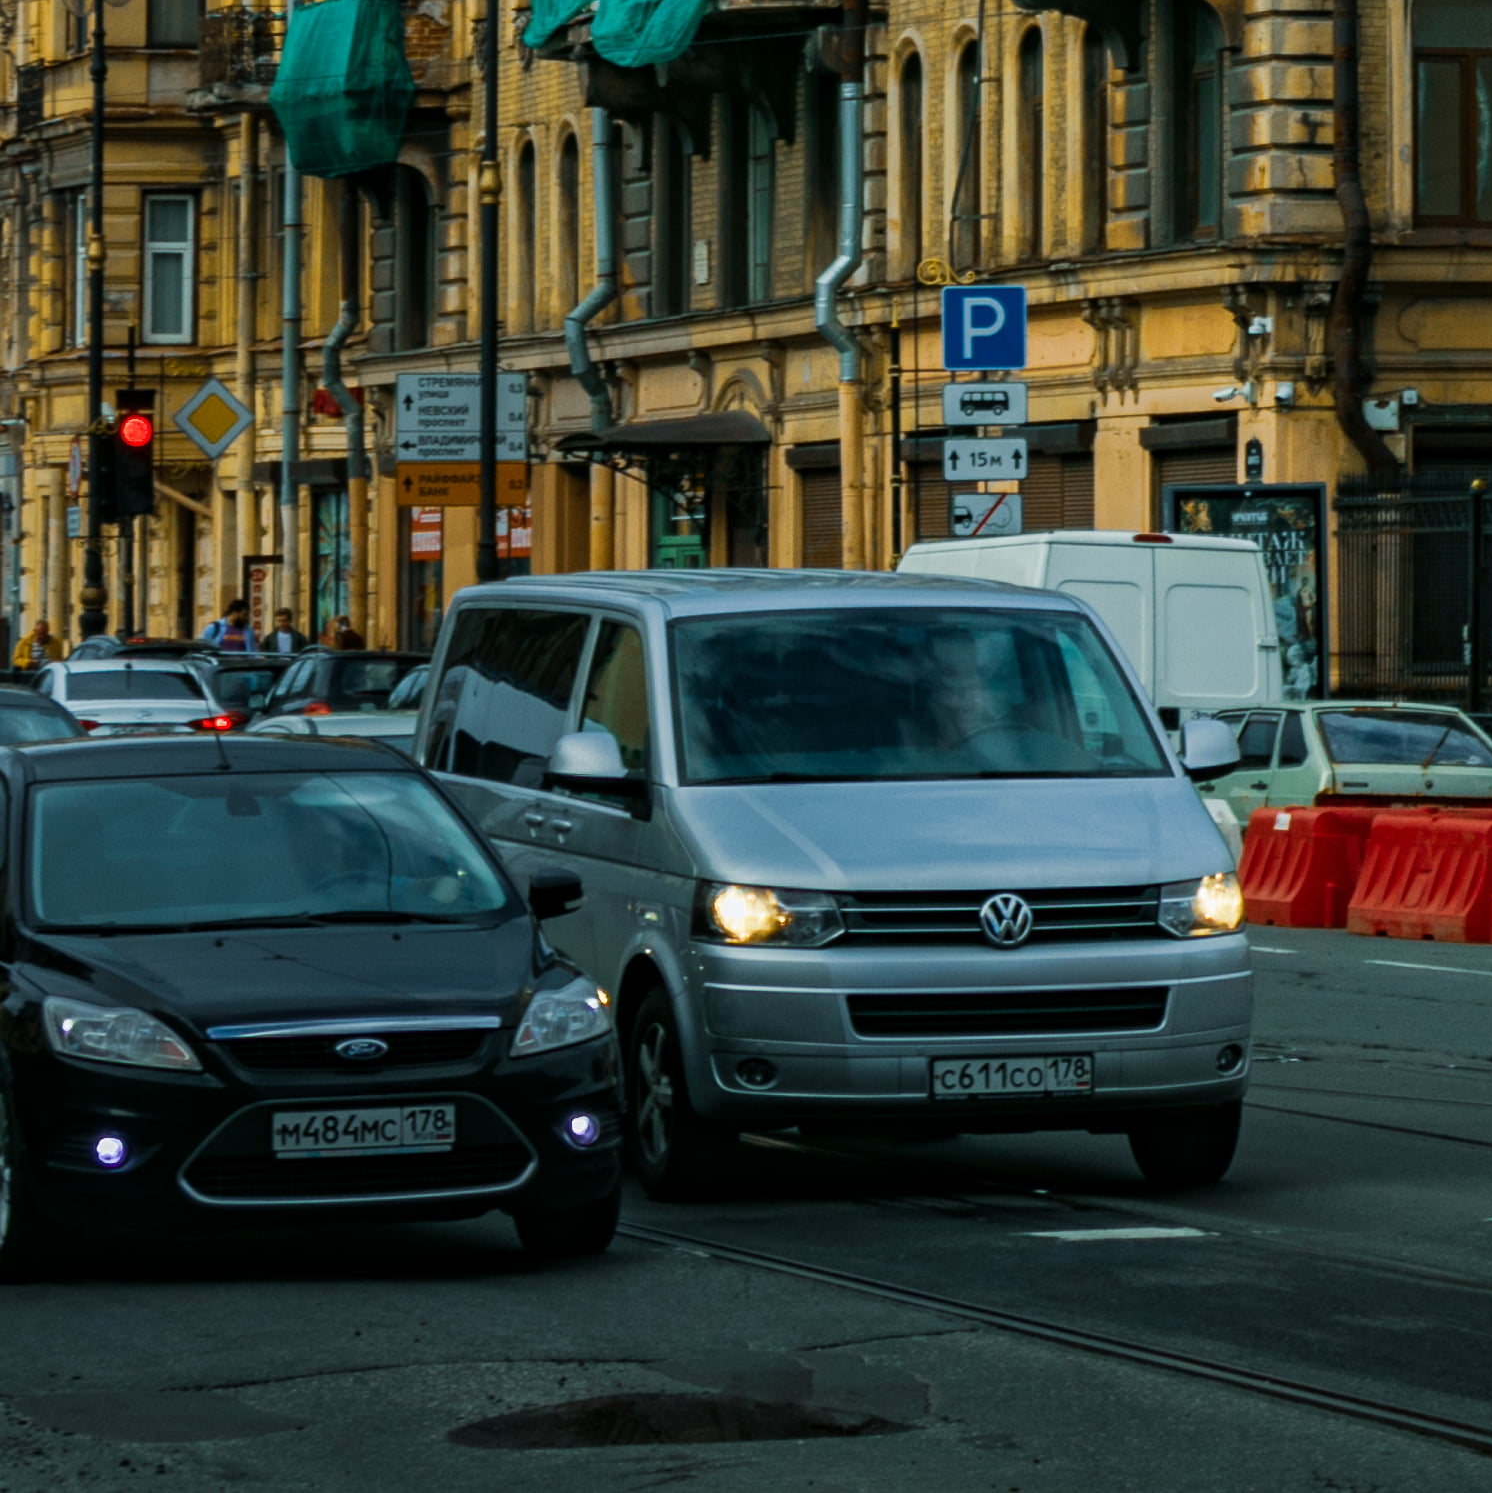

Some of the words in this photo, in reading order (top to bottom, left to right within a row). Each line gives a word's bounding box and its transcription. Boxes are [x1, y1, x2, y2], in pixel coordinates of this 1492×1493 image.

[962, 296, 1006, 360] P
[418, 377, 482, 388] СТРЕМЯННА
[418, 403, 469, 416] НЕВСКИЙ
[418, 418, 466, 428] проспект
[418, 447, 465, 458] проспект
[940, 1062, 1044, 1090] С611СО
[1048, 1058, 1086, 1080] 178
[280, 1114, 398, 1146] М484МС
[405, 1109, 447, 1132] 178
